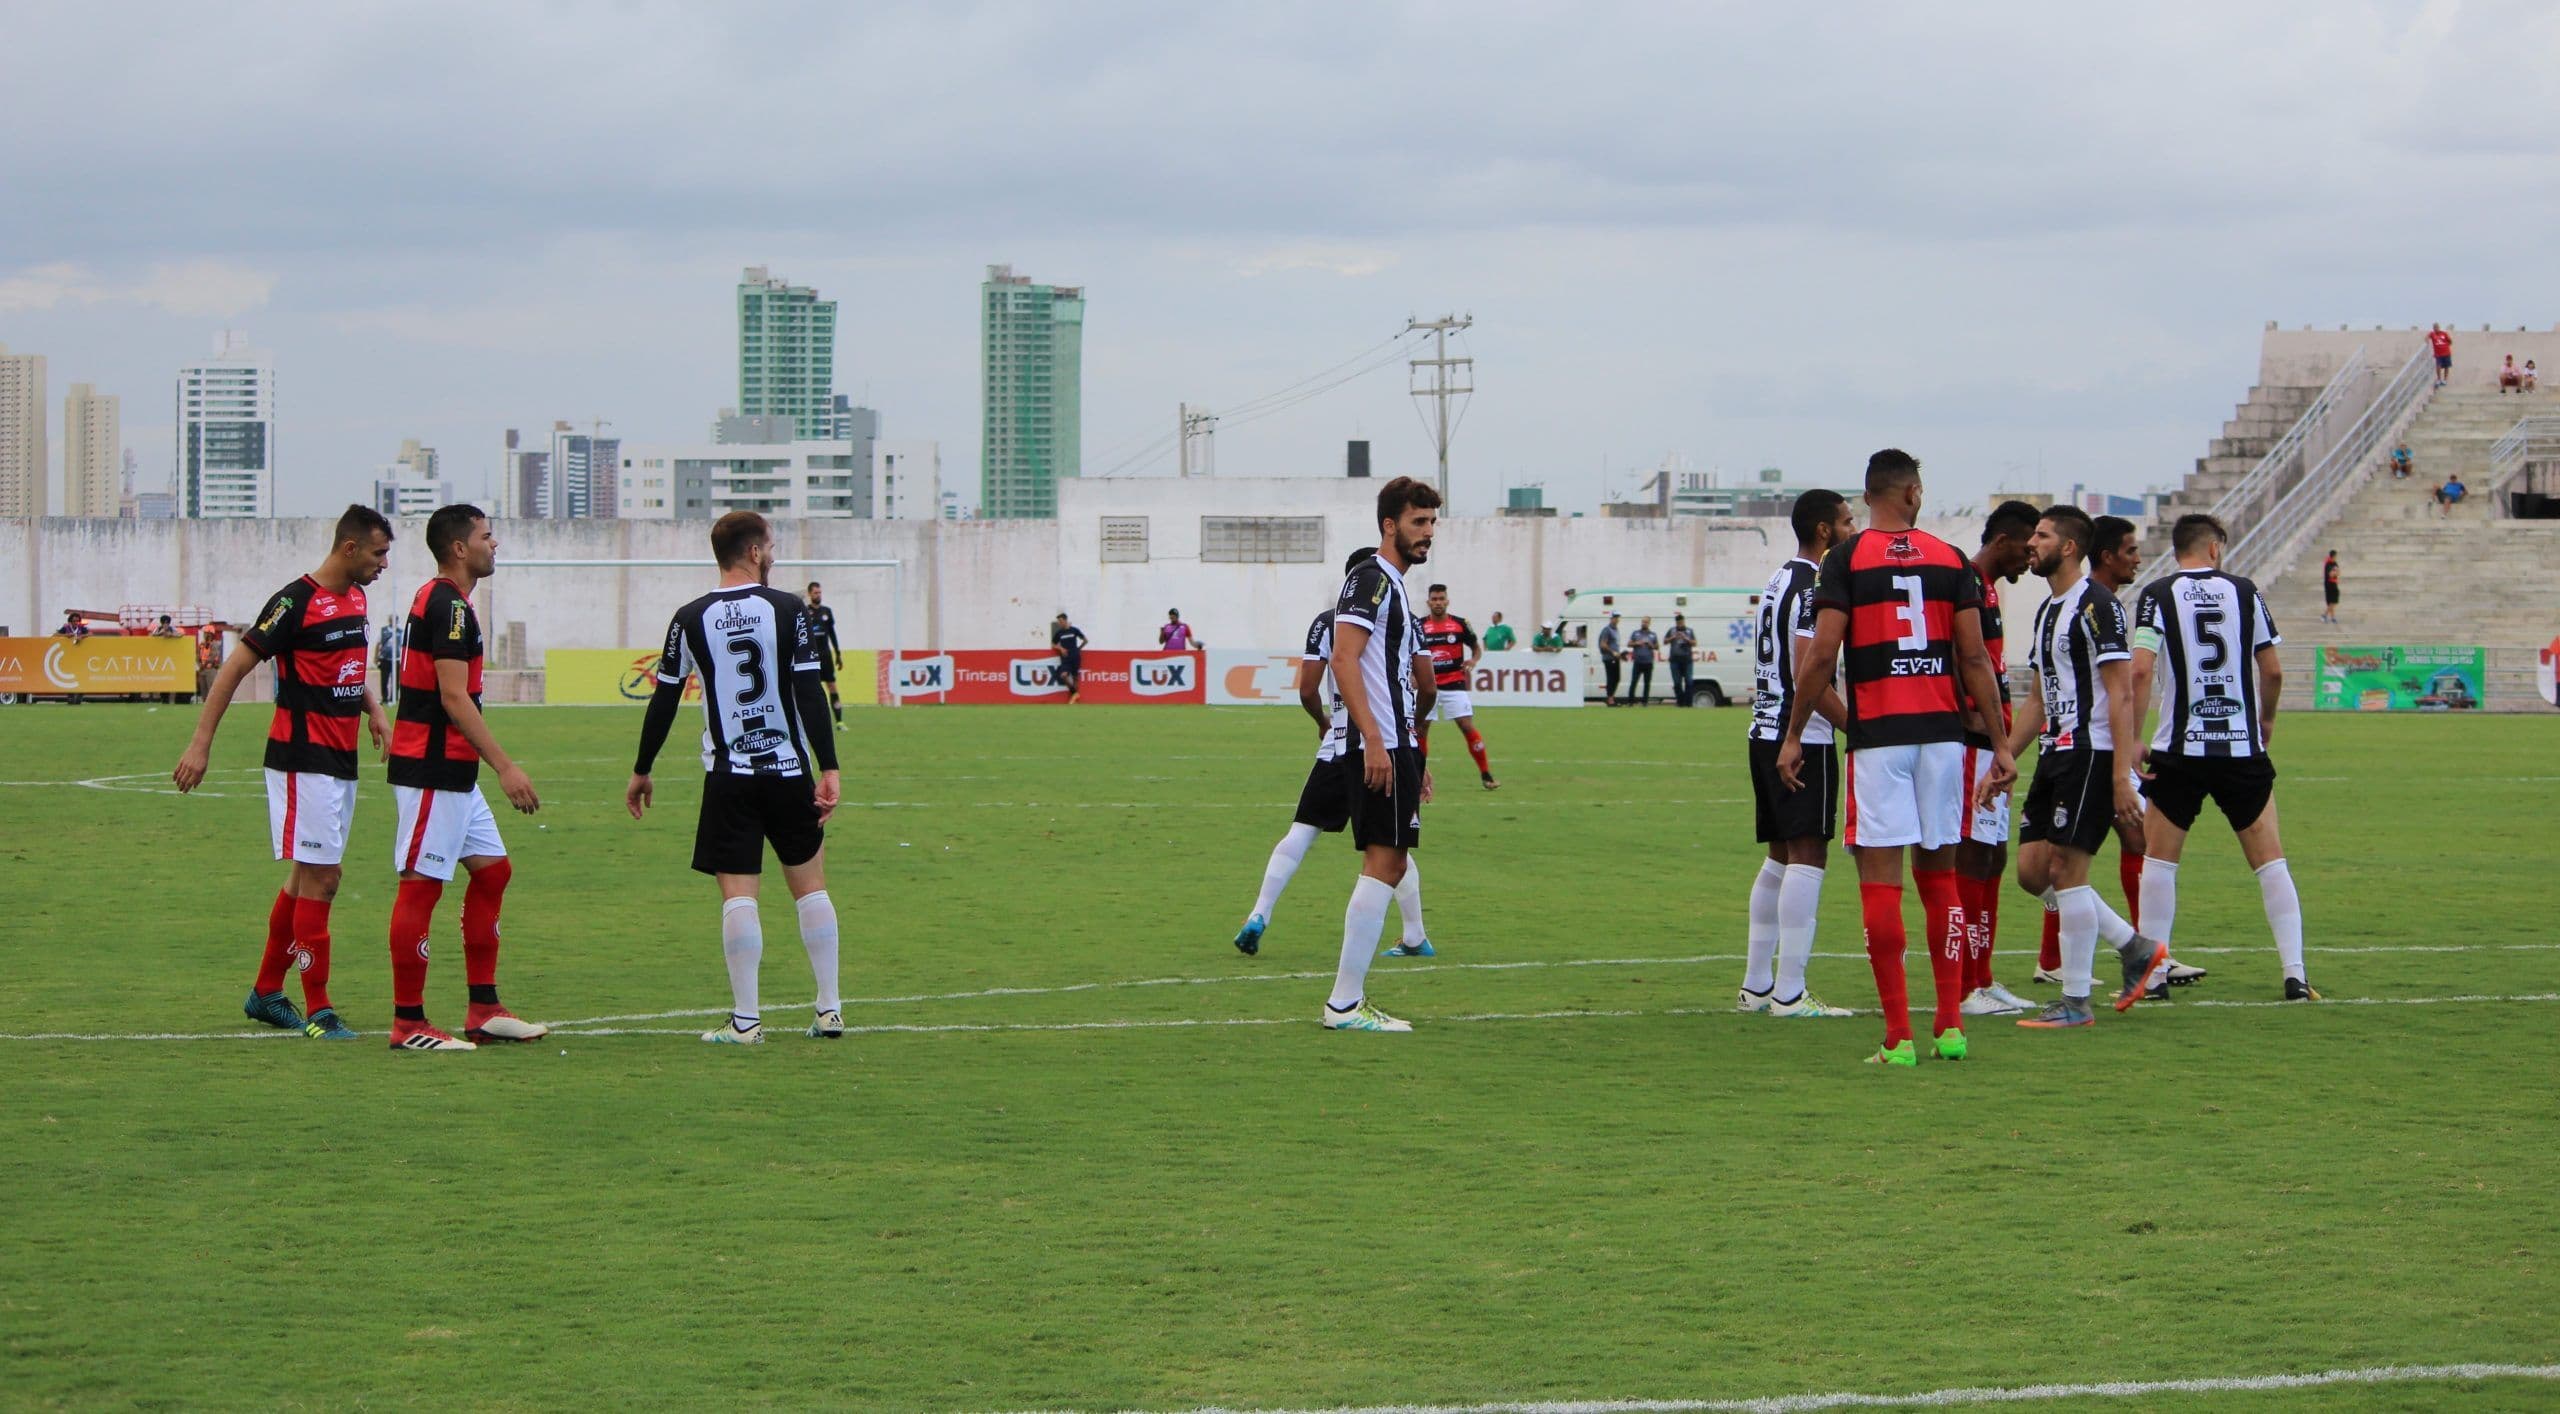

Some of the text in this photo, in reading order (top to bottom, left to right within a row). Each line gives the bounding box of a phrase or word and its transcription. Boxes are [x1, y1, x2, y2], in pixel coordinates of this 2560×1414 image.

[1892, 575, 1928, 650] 3
[715, 614, 762, 631] Campina
[2192, 609, 2229, 673] 5
[87, 656, 176, 672] CATIVA
[727, 636, 768, 707] 3
[1890, 657, 1942, 675] SEVEN
[956, 669, 1007, 682] Tintas
[1078, 669, 1129, 682] Tintas
[731, 704, 775, 720] ARENO
[733, 735, 784, 753] Compras
[1944, 906, 1965, 962] SEVEN
